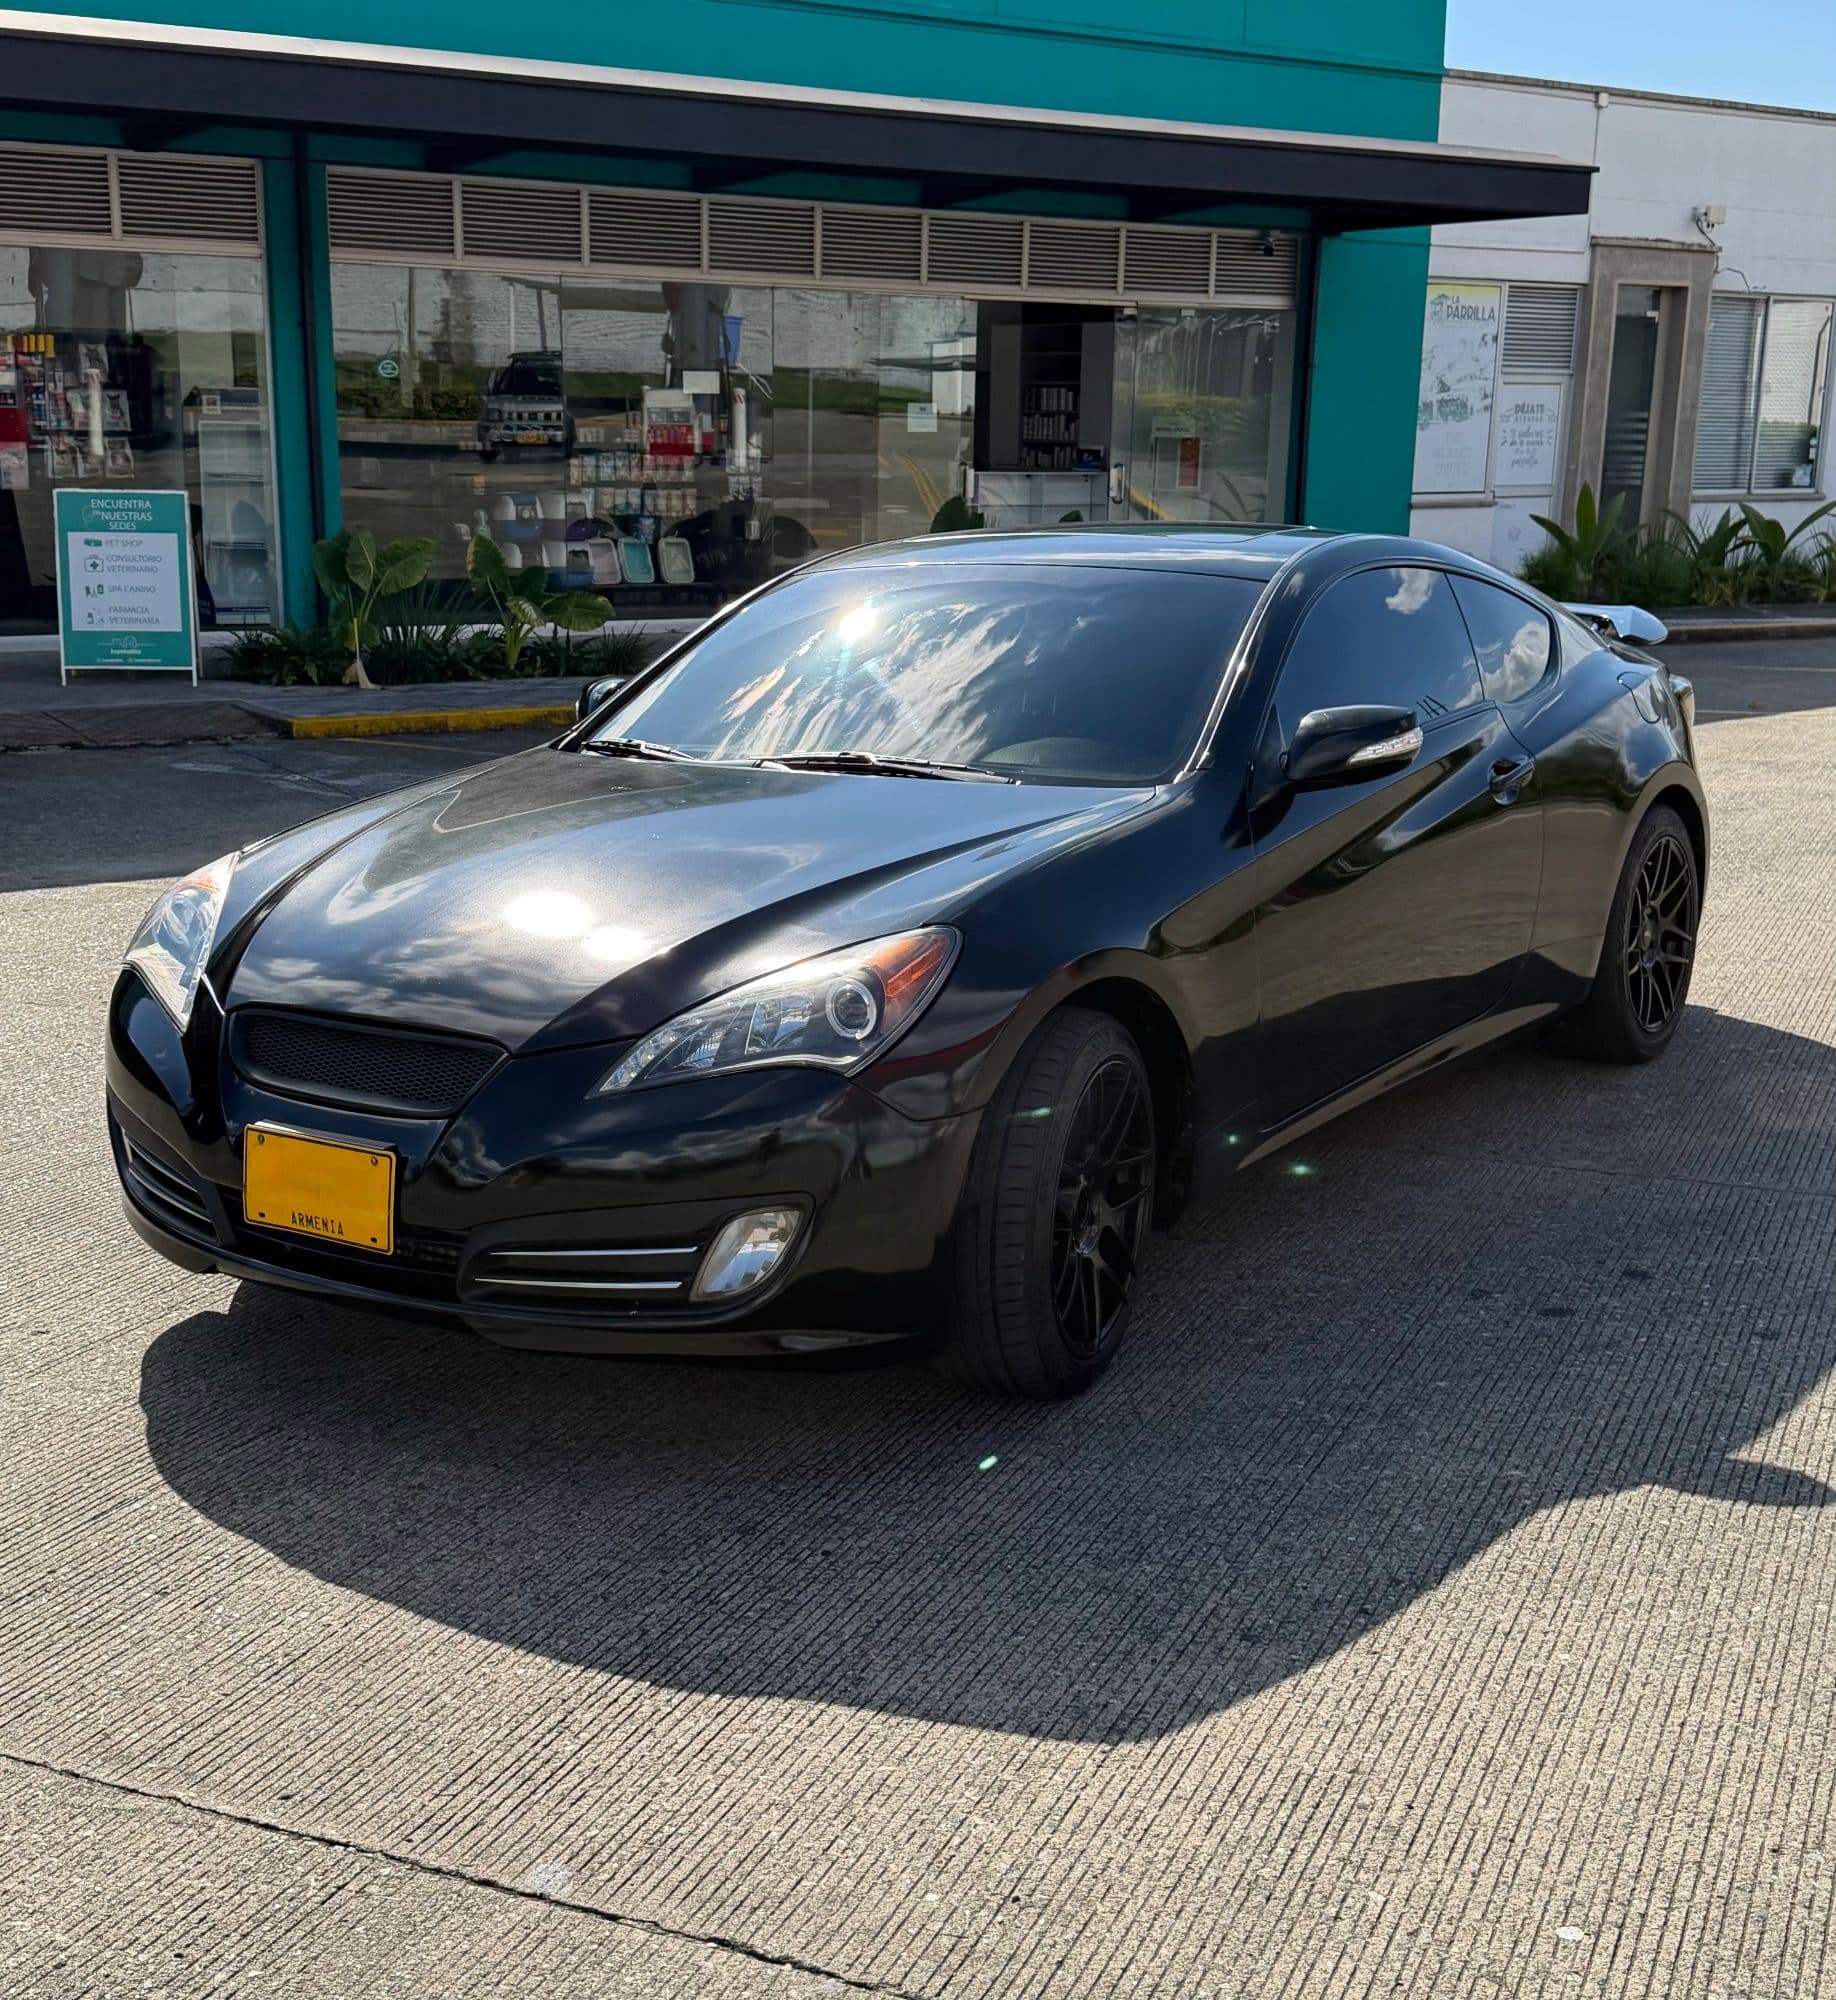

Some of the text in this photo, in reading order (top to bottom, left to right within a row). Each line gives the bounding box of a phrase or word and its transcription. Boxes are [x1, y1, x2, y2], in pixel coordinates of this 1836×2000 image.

[1451, 295, 1460, 304] LA
[1446, 304, 1496, 321] PARRILLA
[90, 499, 152, 509] ENCUENTRA
[101, 511, 153, 521] NUESTRAS
[109, 521, 137, 531] SEDES
[105, 539, 119, 547] PET
[105, 554, 162, 563] CONSULTORIO
[106, 565, 159, 574] VETERINARIO
[107, 585, 157, 594] SPA CANINO
[108, 606, 150, 614] FARMACIA
[108, 616, 160, 625] VETERINARIA
[290, 1211, 344, 1236] ARMENIA
